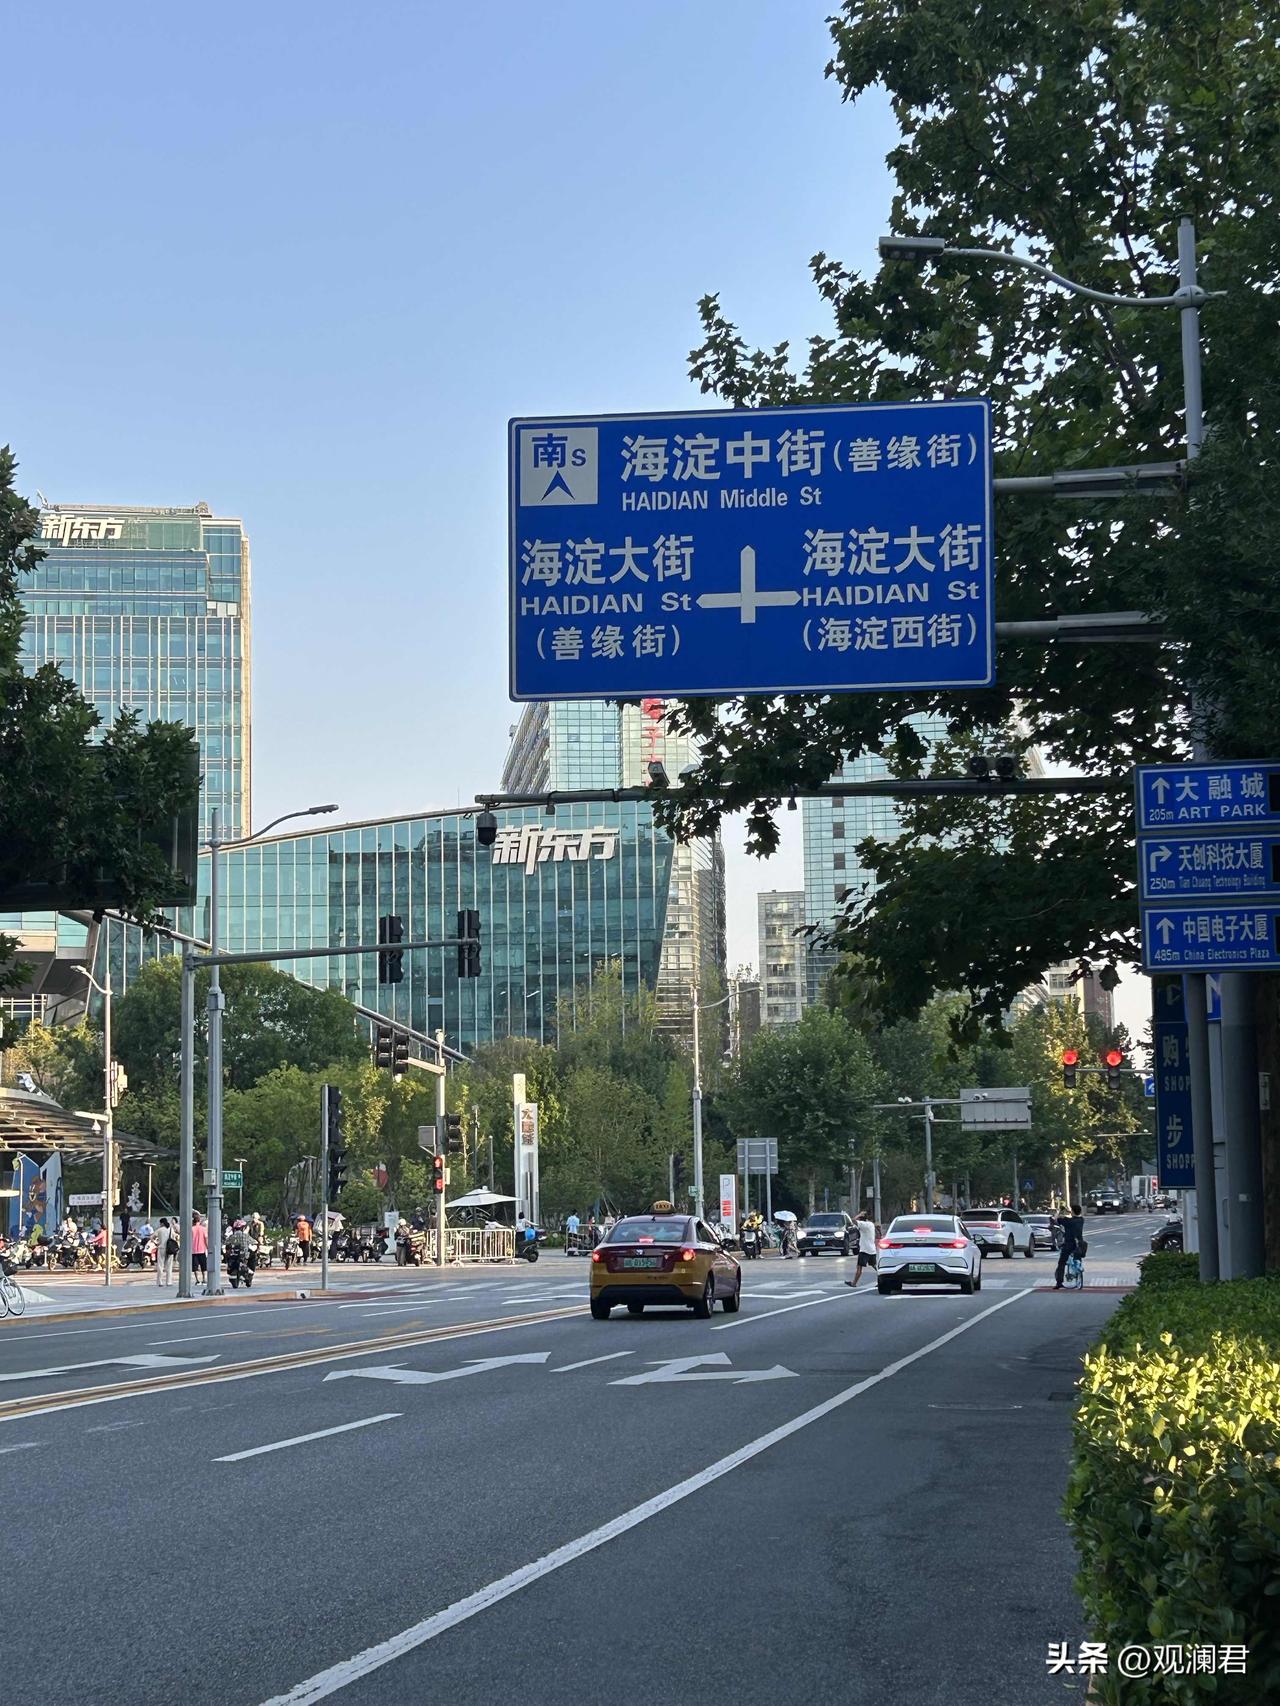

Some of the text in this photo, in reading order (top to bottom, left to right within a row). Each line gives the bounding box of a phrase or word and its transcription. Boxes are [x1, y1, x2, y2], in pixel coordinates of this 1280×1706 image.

[532, 433, 587, 468] 南 S
[622, 485, 822, 512] HAIDIAN Middle St
[41, 514, 125, 547] 新东方
[521, 533, 695, 587] 海淀大街
[802, 523, 983, 577] 海淀大街
[521, 591, 692, 616] HAIDIAN St
[802, 580, 980, 607] HAIDIAN St
[536, 624, 681, 661] (善缘街)
[802, 613, 977, 652] (海淀西街)
[1175, 772, 1265, 802] 大融城
[1178, 805, 1212, 820] ART
[1220, 803, 1266, 818] PARK
[492, 823, 620, 876] 新东方
[1178, 841, 1264, 872] 天创科技大厦
[1182, 913, 1269, 944] 中国电子大厦
